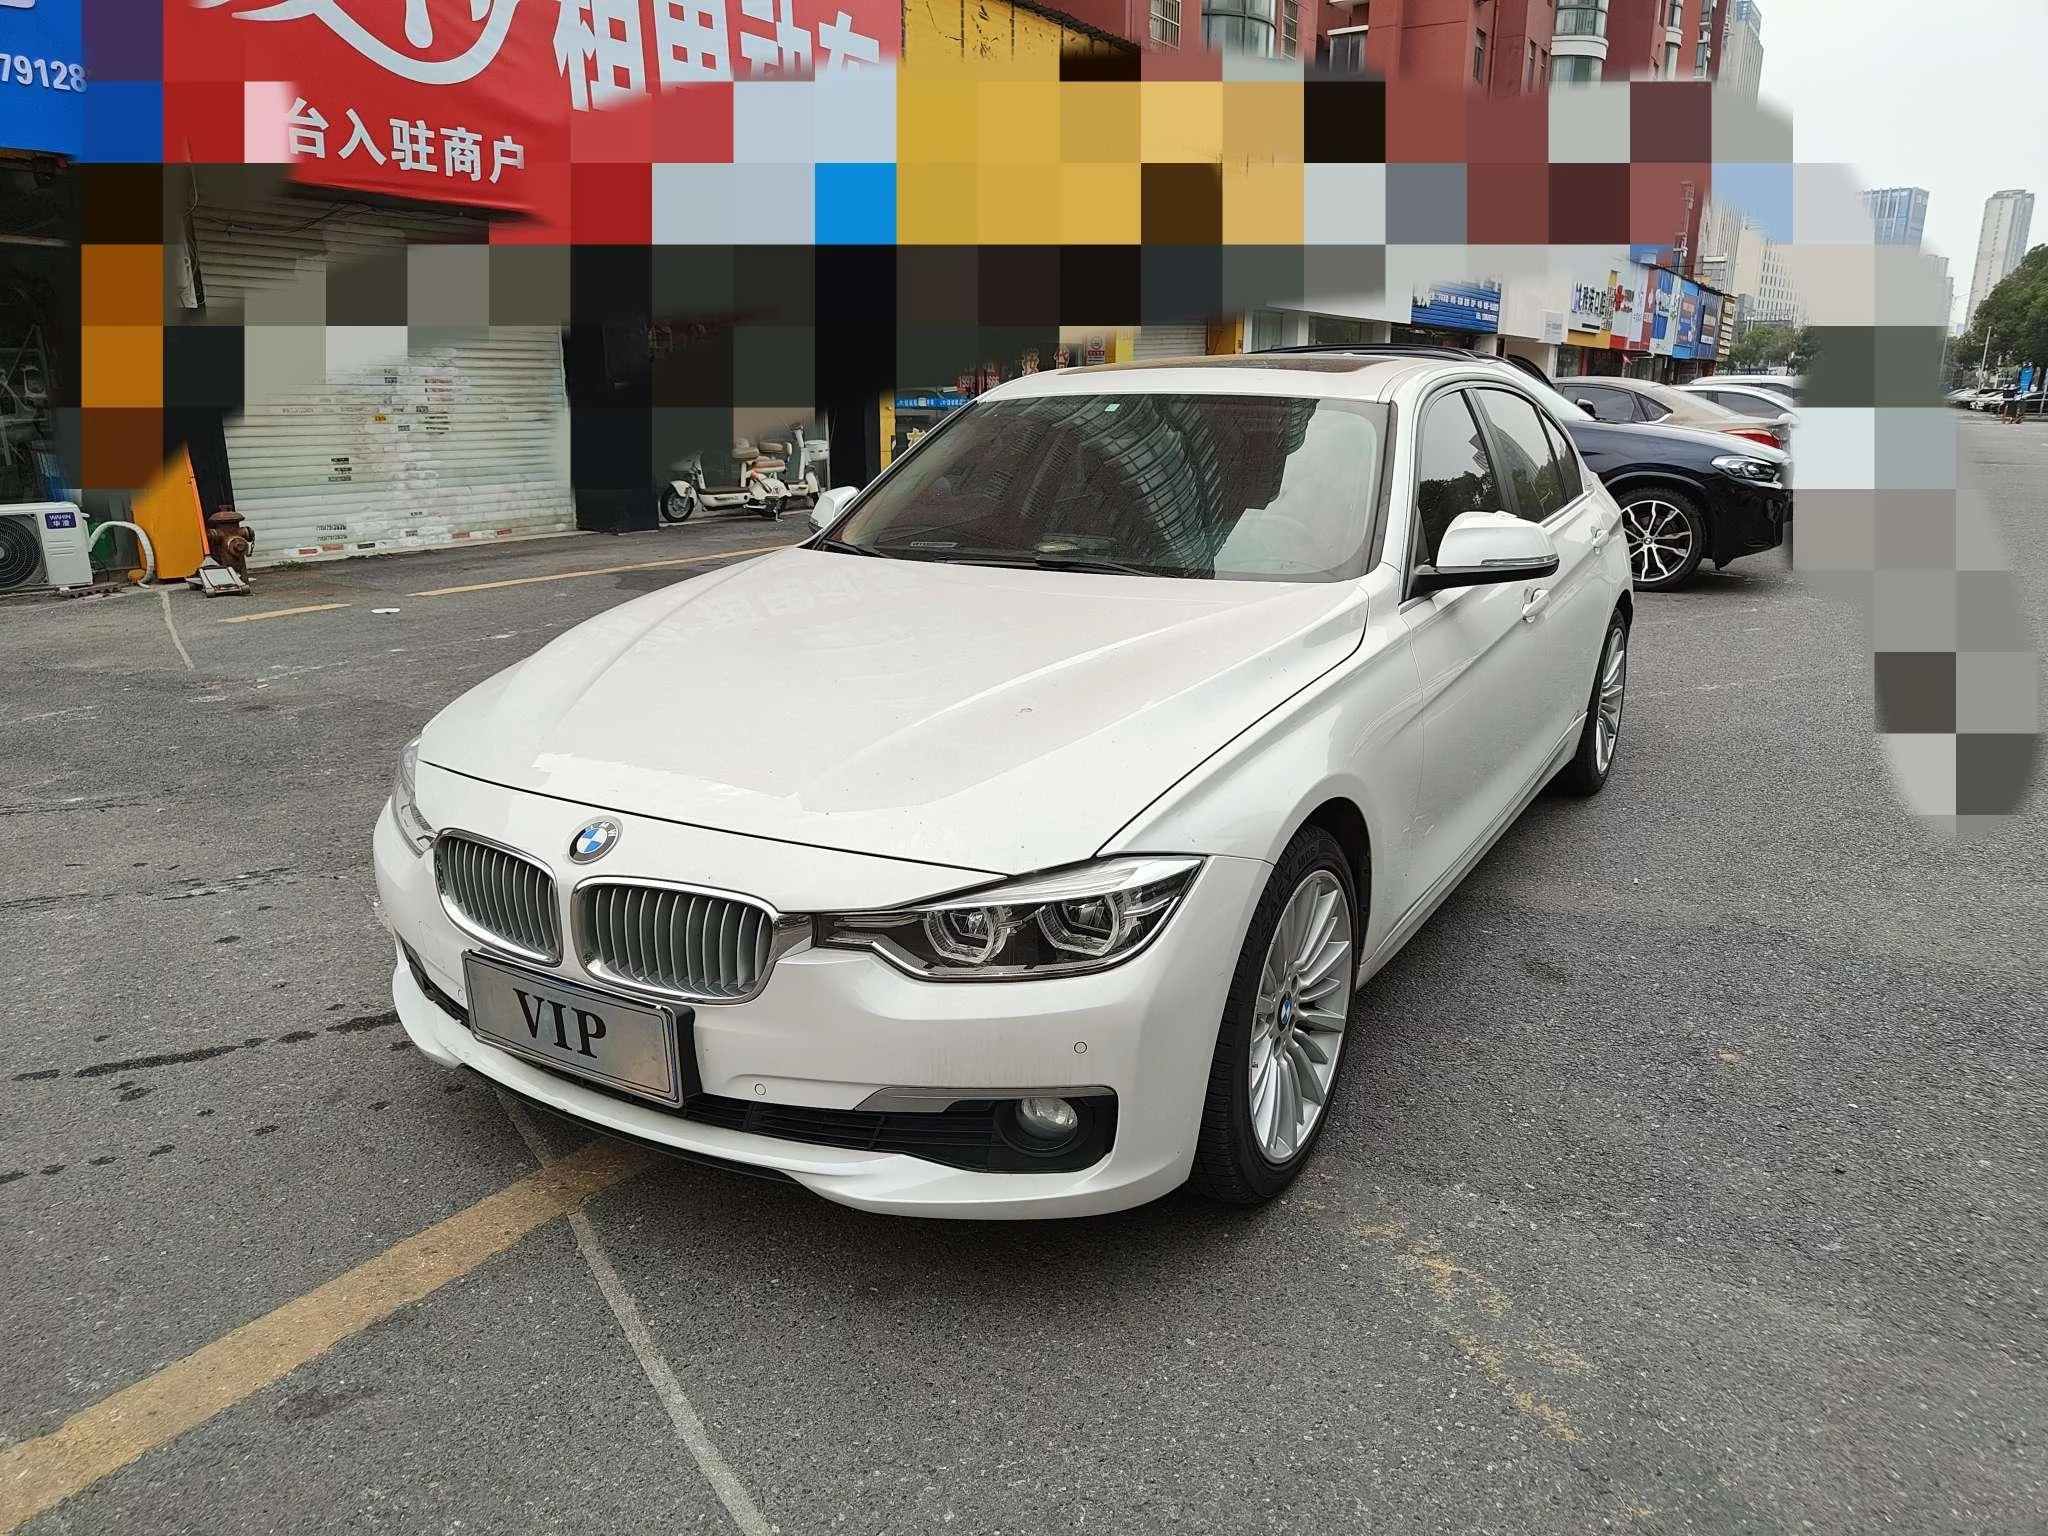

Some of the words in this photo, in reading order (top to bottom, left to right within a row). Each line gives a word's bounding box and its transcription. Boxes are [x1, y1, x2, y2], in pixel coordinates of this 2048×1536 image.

[287, 97, 525, 184] 台入驻商户
[513, 988, 606, 1059] VIP
